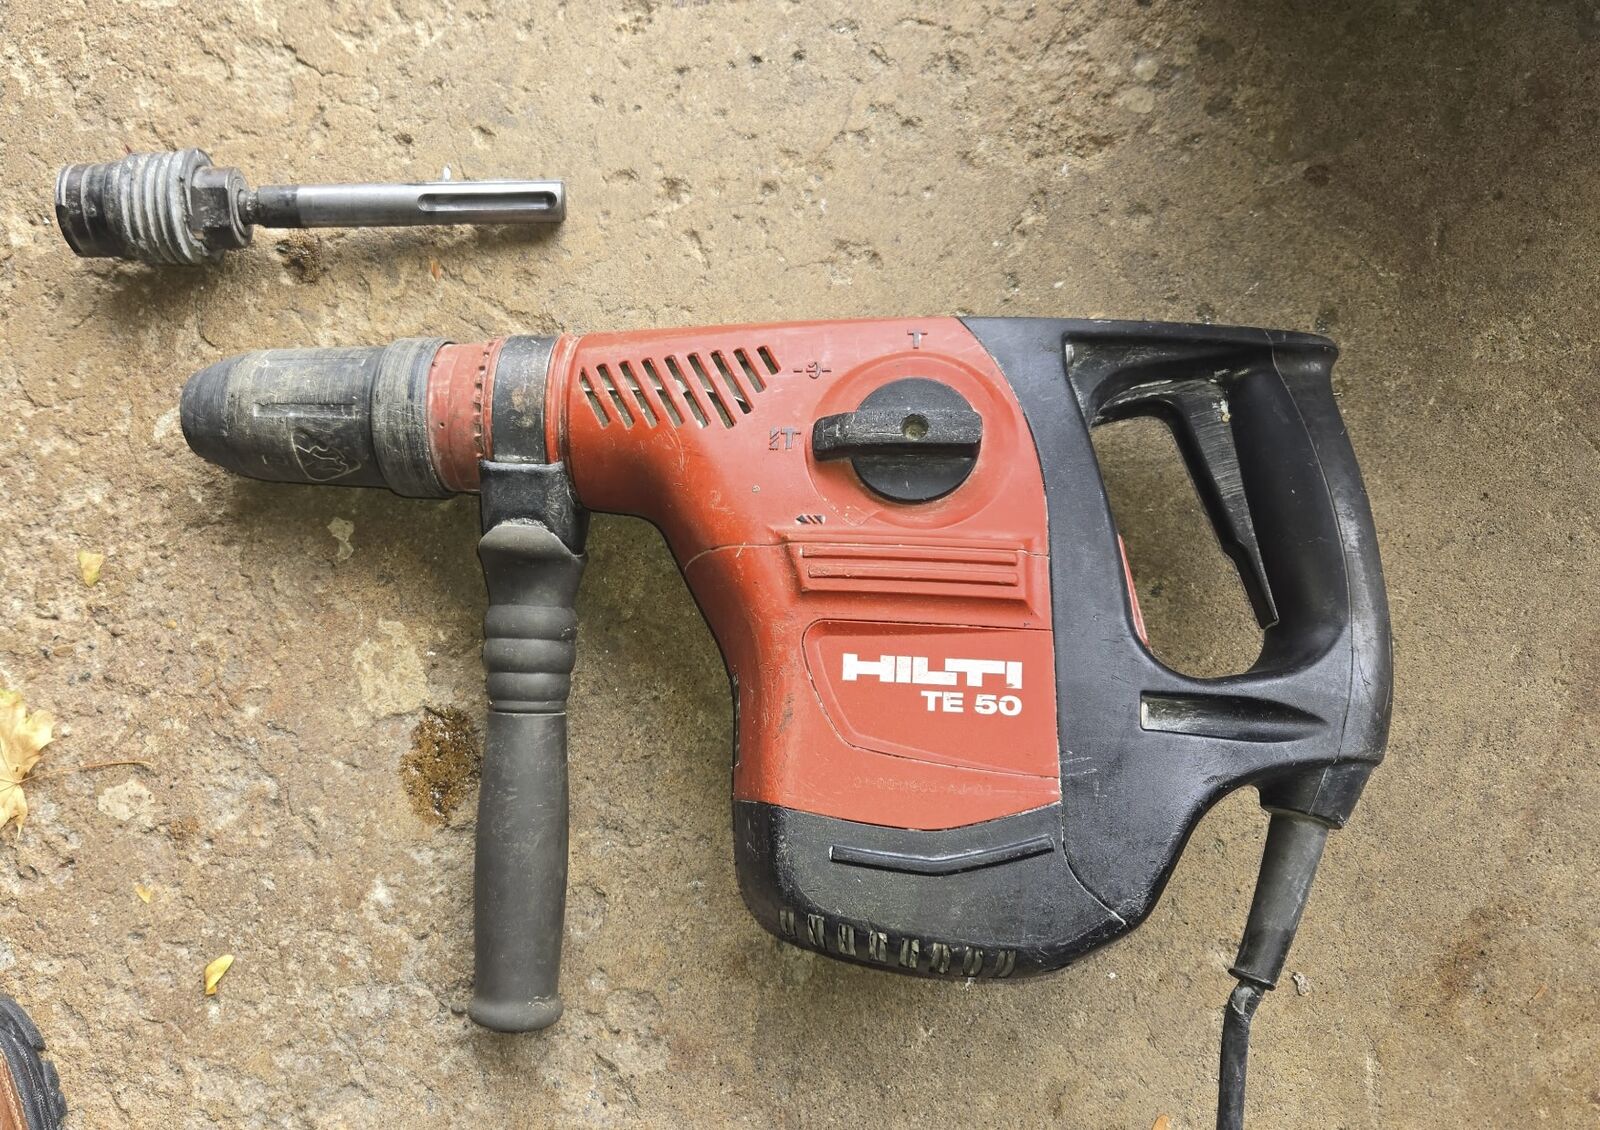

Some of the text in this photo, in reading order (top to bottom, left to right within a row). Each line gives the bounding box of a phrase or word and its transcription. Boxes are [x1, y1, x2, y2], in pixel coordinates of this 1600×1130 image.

[842, 653, 1023, 689] HILTI
[920, 690, 1023, 716] TE 50
